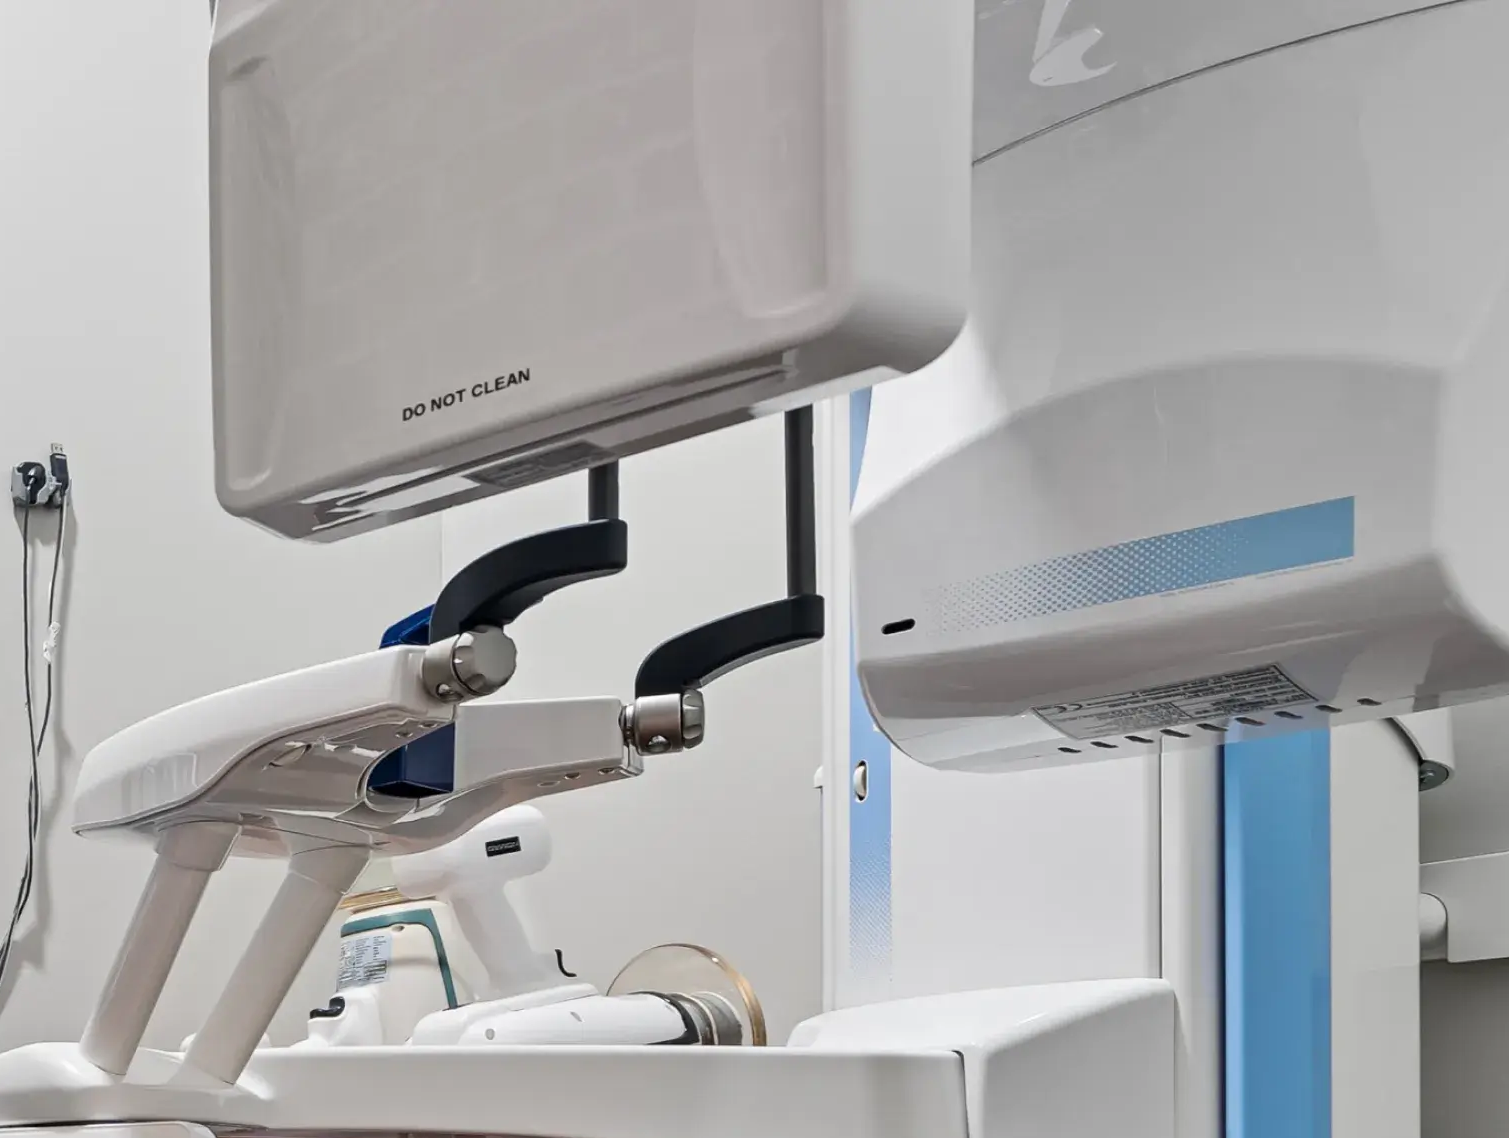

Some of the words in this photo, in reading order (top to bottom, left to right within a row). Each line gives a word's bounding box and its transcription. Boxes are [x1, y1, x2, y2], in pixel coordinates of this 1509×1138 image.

[402, 402, 426, 421] DO
[430, 388, 466, 412] NOT
[471, 368, 530, 398] CLEAN
